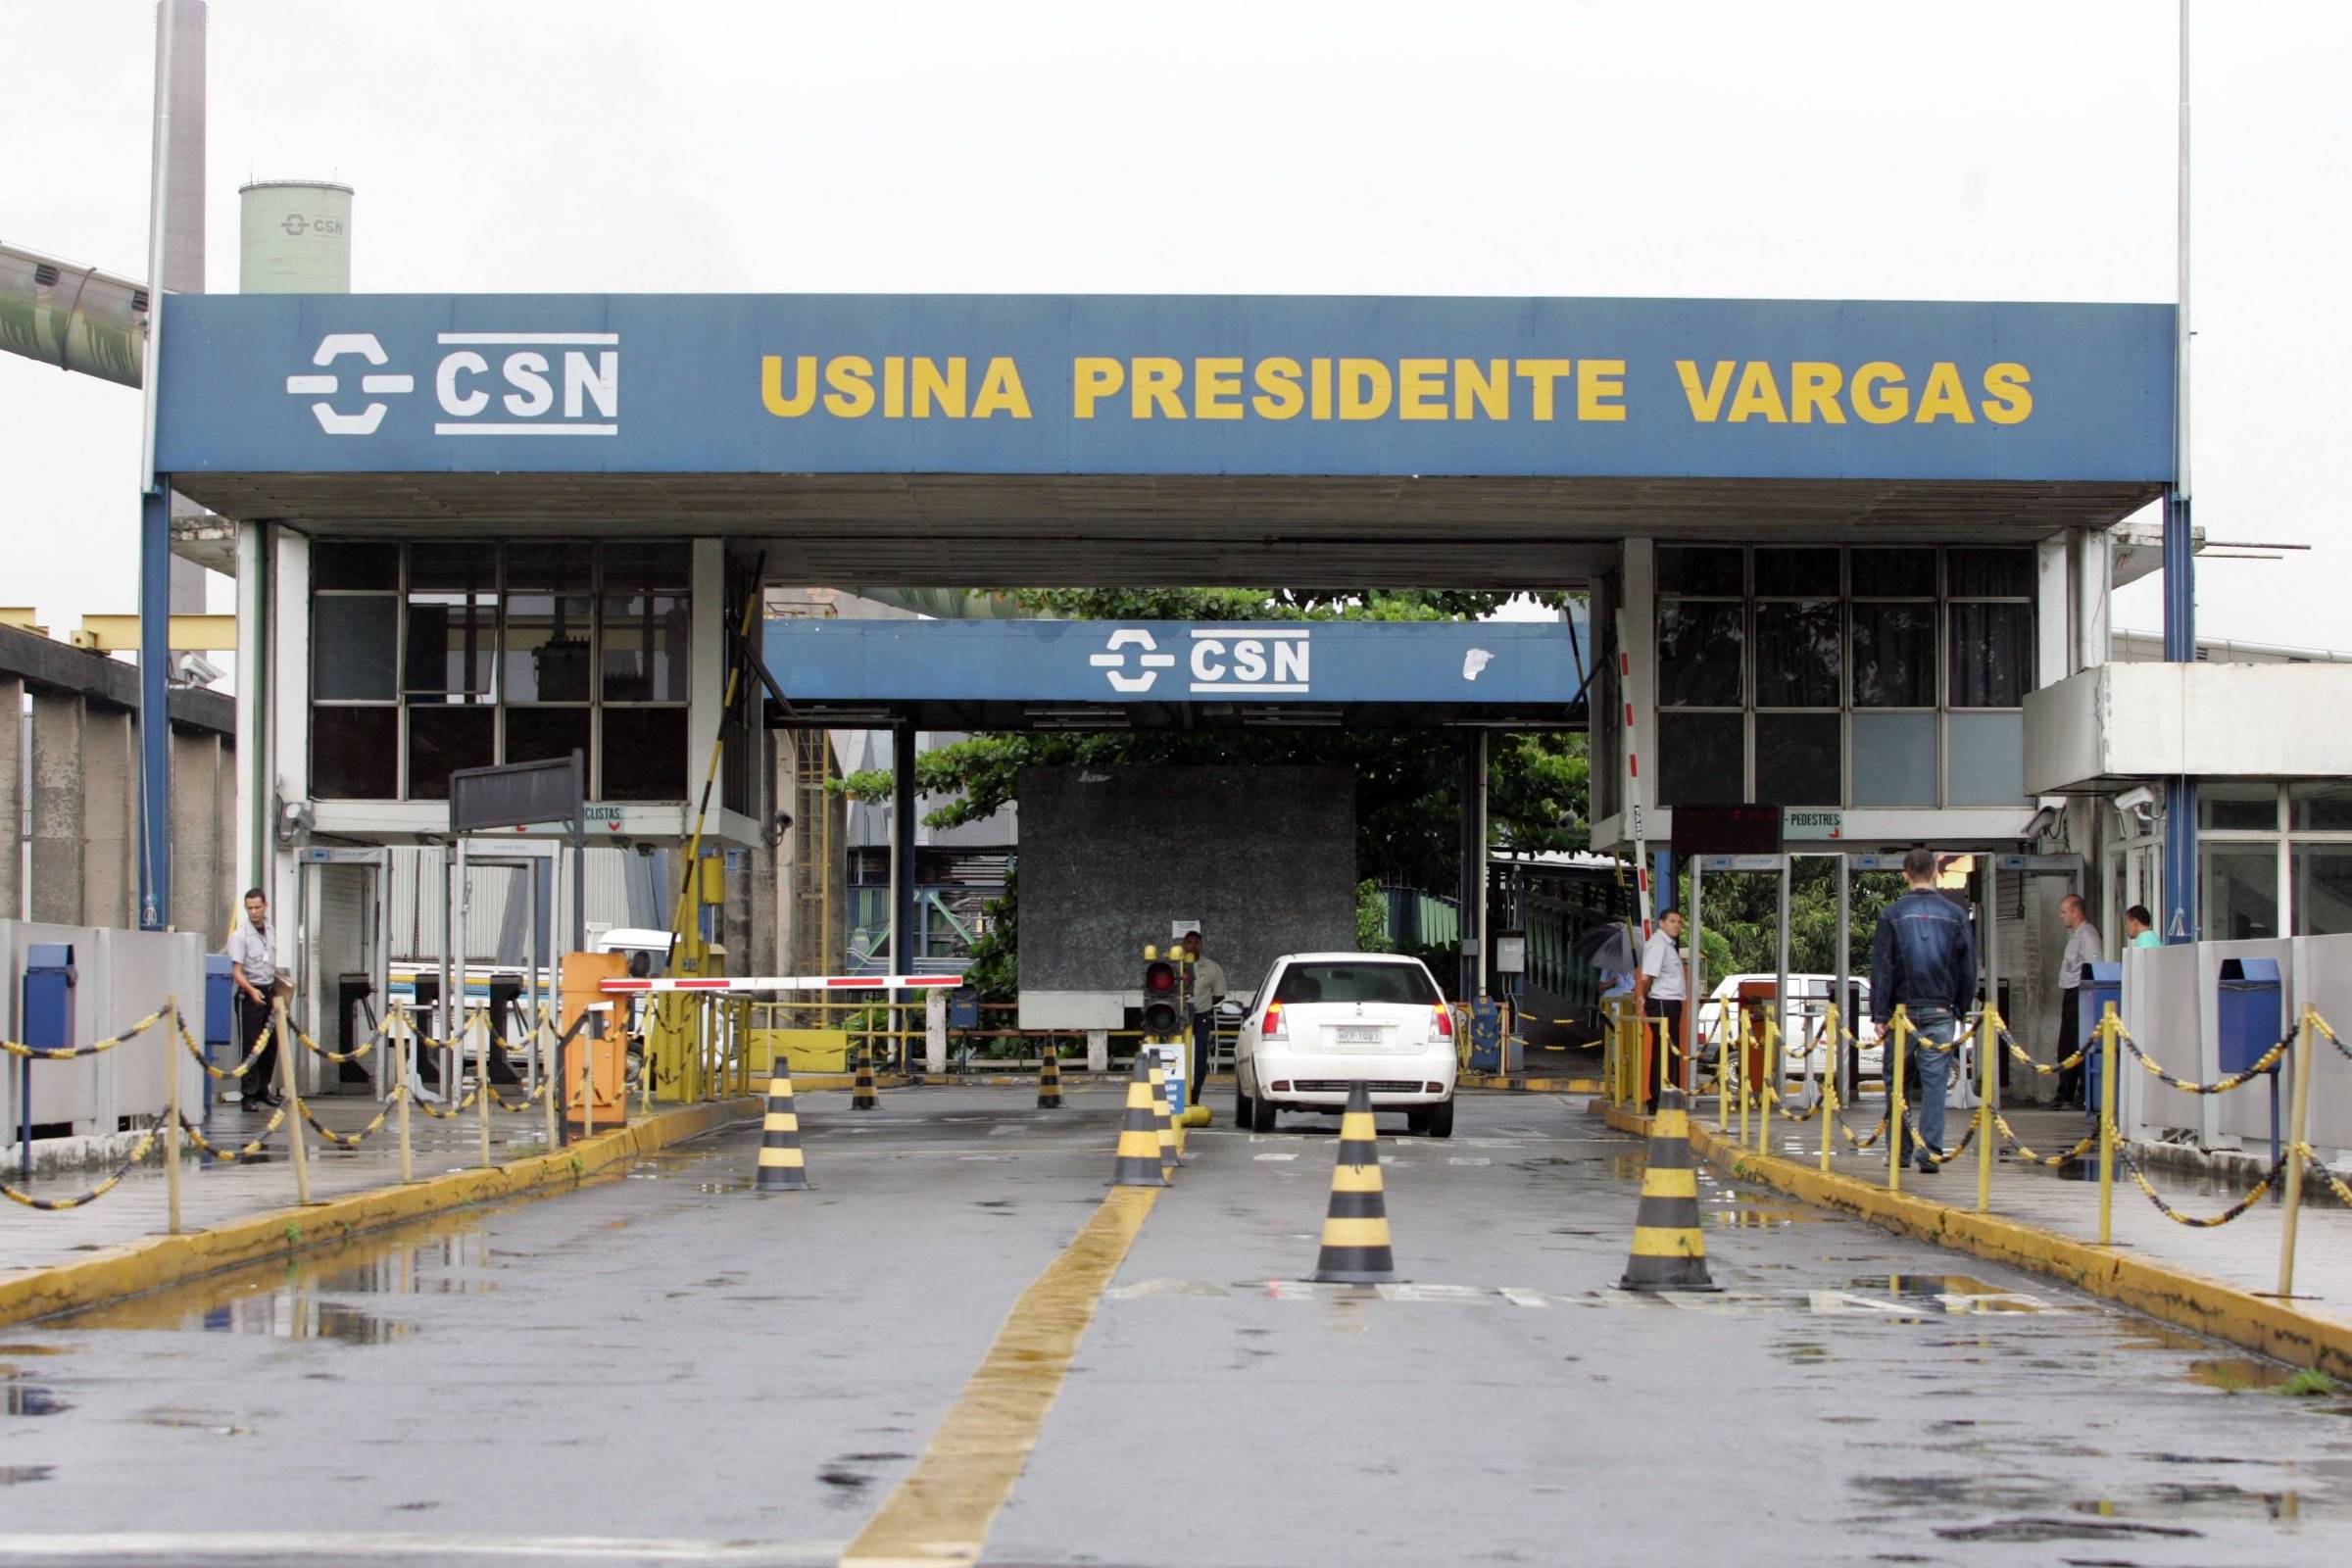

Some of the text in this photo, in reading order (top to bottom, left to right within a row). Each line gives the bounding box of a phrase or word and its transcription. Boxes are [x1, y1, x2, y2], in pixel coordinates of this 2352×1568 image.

[314, 219, 343, 235] CSN
[435, 351, 618, 417] CSN
[762, 355, 2034, 424] USINA PRESIDENTE VARGAS
[1190, 639, 1309, 682] CSN
[1790, 813, 1840, 826] PEDESTRES
